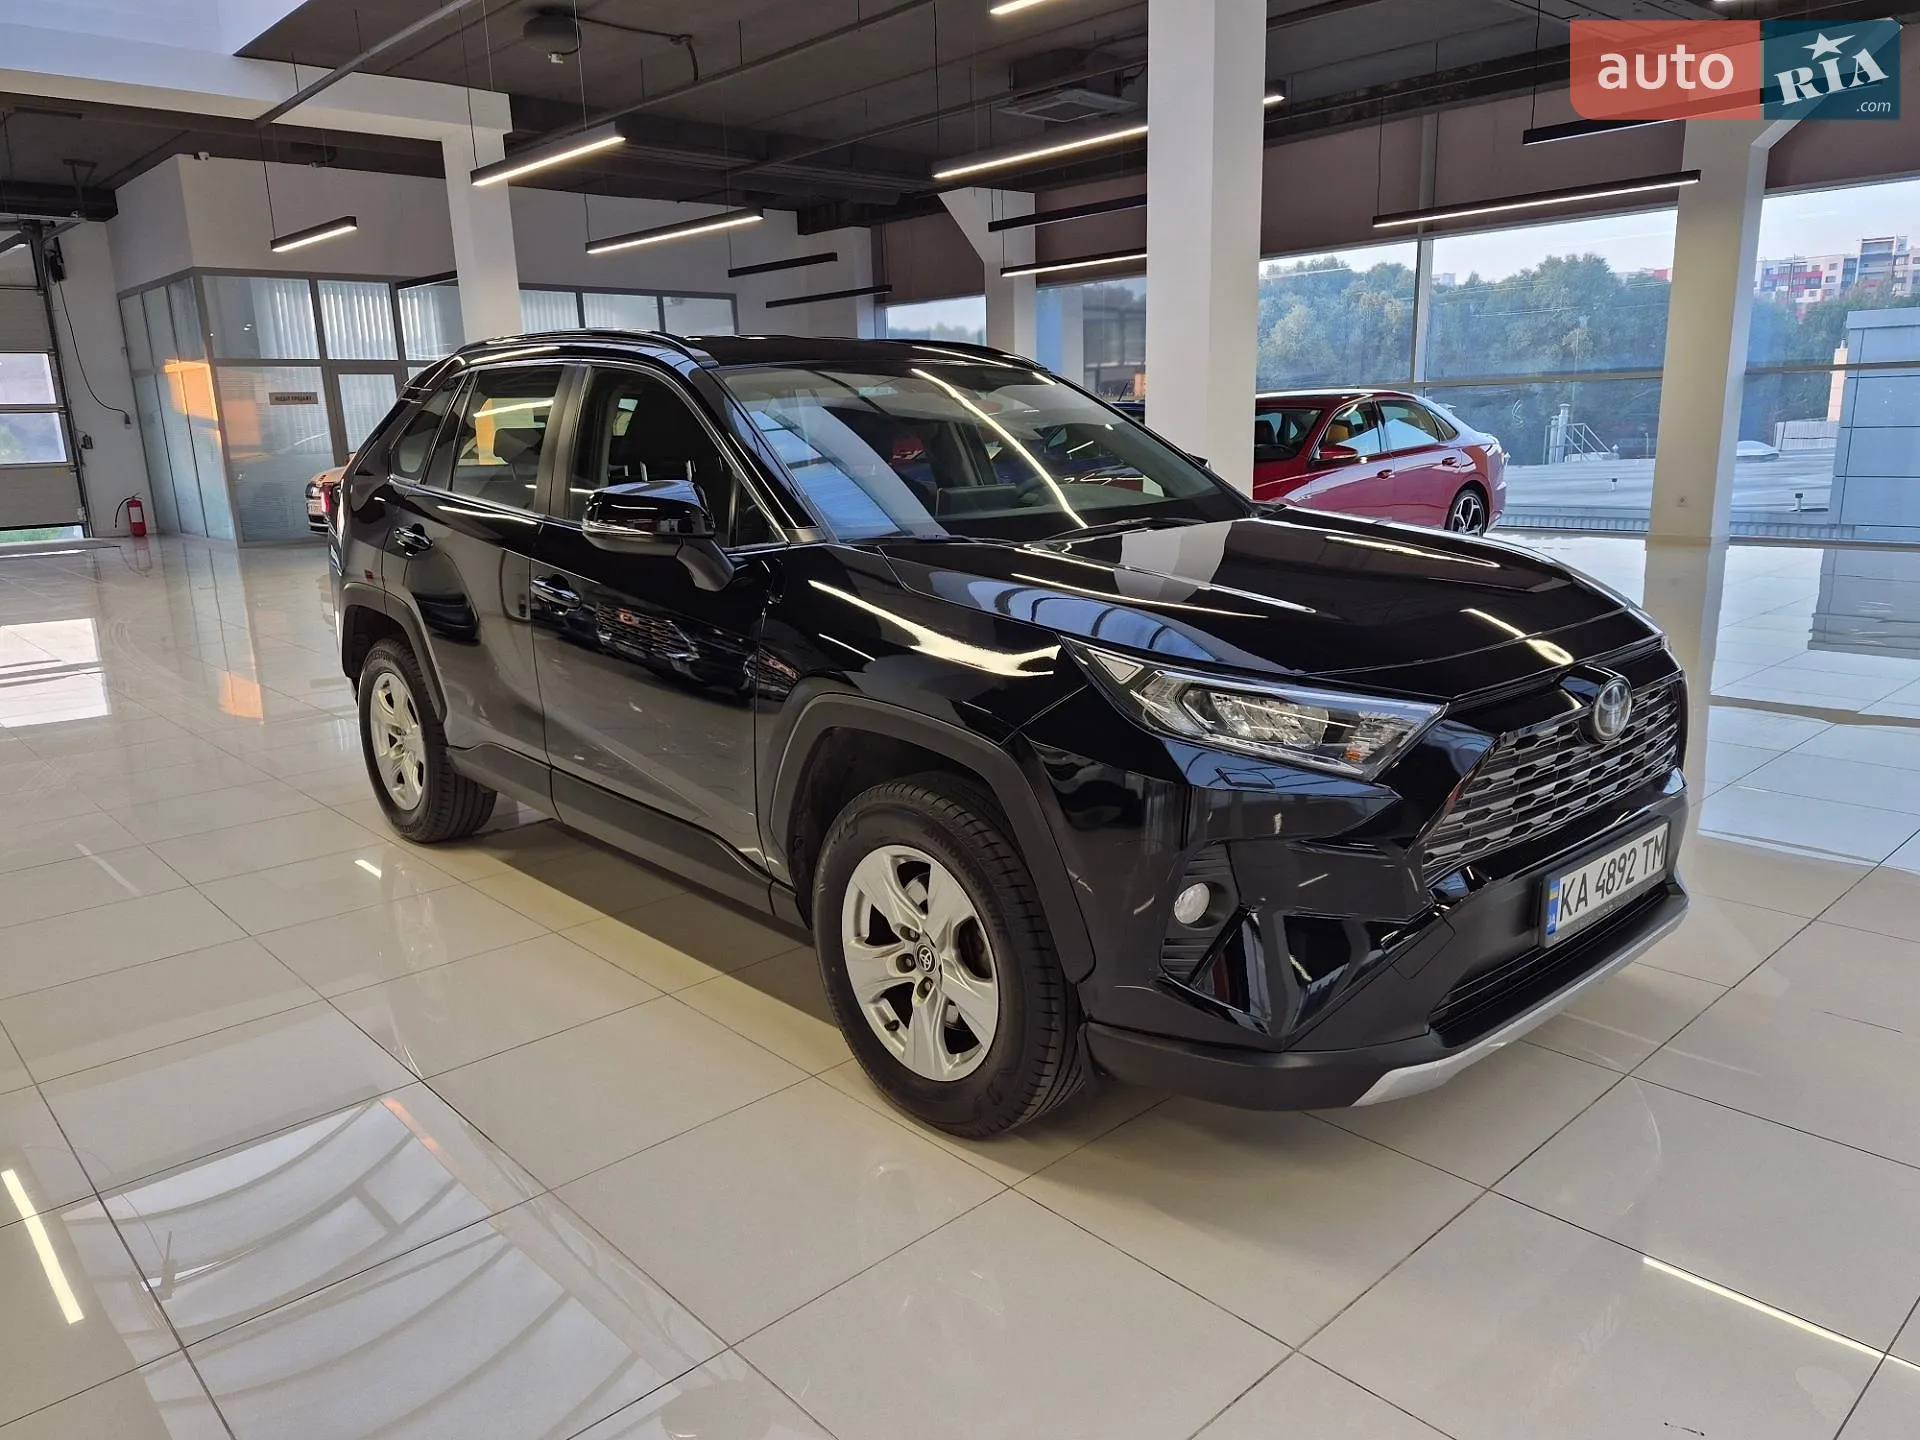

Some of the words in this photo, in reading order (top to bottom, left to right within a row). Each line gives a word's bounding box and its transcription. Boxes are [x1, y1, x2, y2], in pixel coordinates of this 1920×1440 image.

[1559, 871, 1589, 922] KA
[1594, 846, 1638, 900] 4892
[1642, 829, 1668, 876] TM
